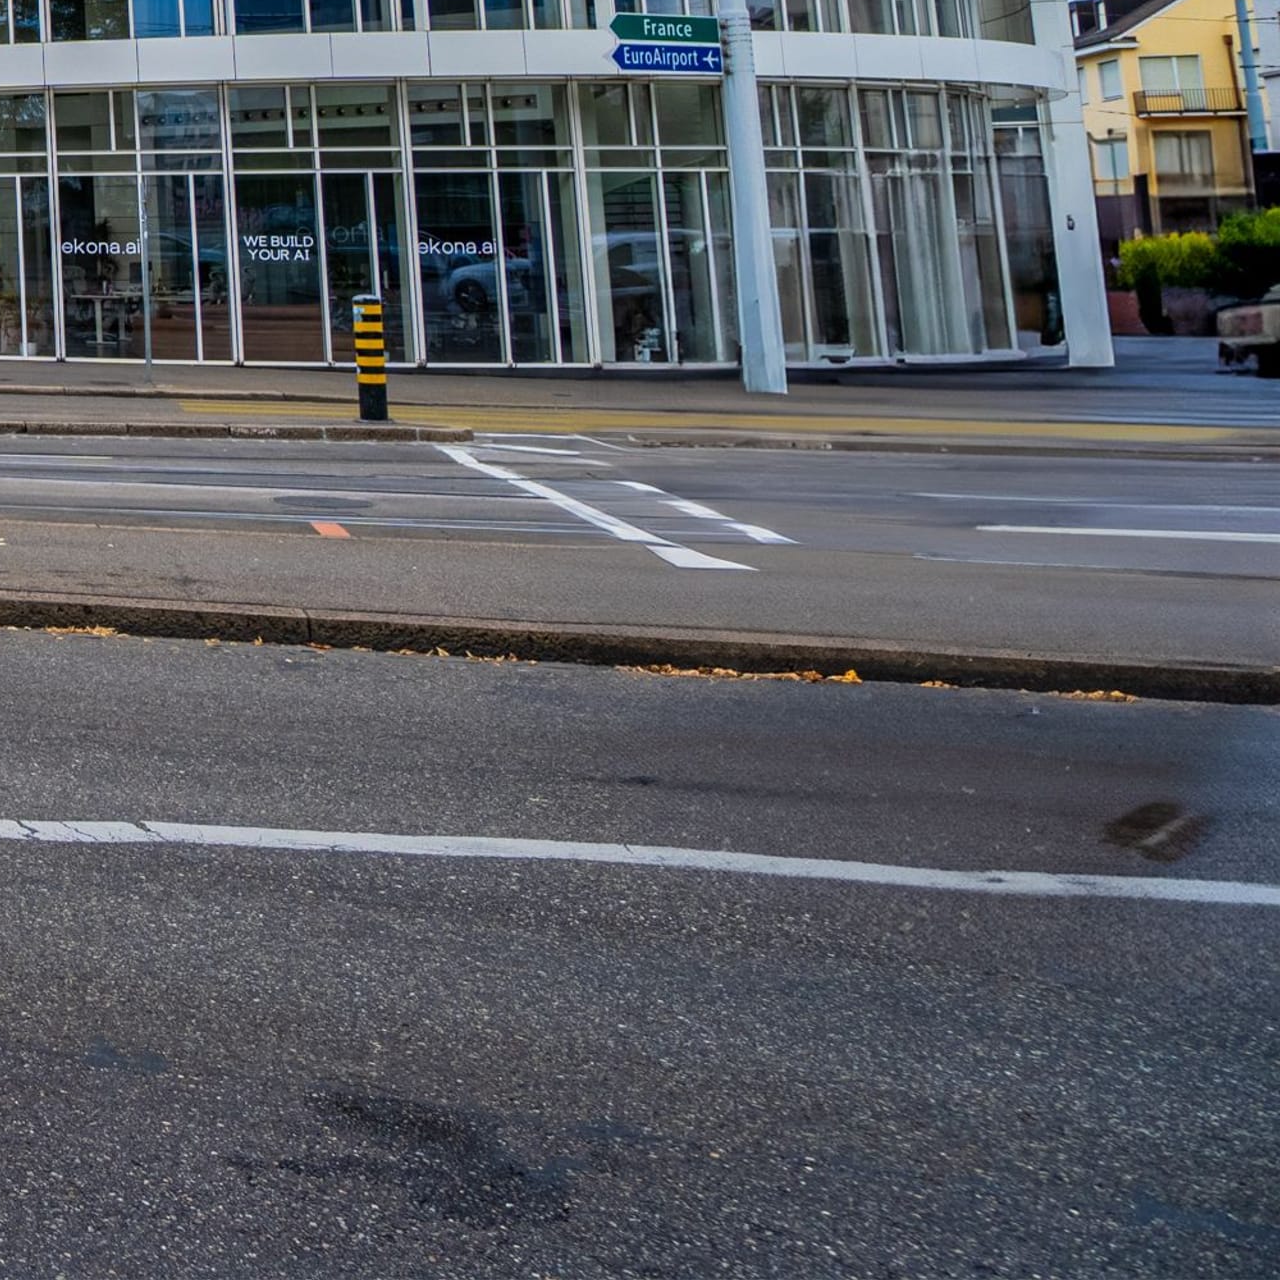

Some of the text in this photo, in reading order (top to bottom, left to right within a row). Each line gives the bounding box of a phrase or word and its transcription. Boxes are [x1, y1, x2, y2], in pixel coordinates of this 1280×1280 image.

[643, 19, 693, 37] France
[623, 46, 700, 70] EuroAirport
[61, 238, 141, 255] ekona.ai
[244, 235, 314, 248] WE BUILD
[417, 238, 498, 255] ekona.ai
[247, 248, 310, 261] YOUR AI
